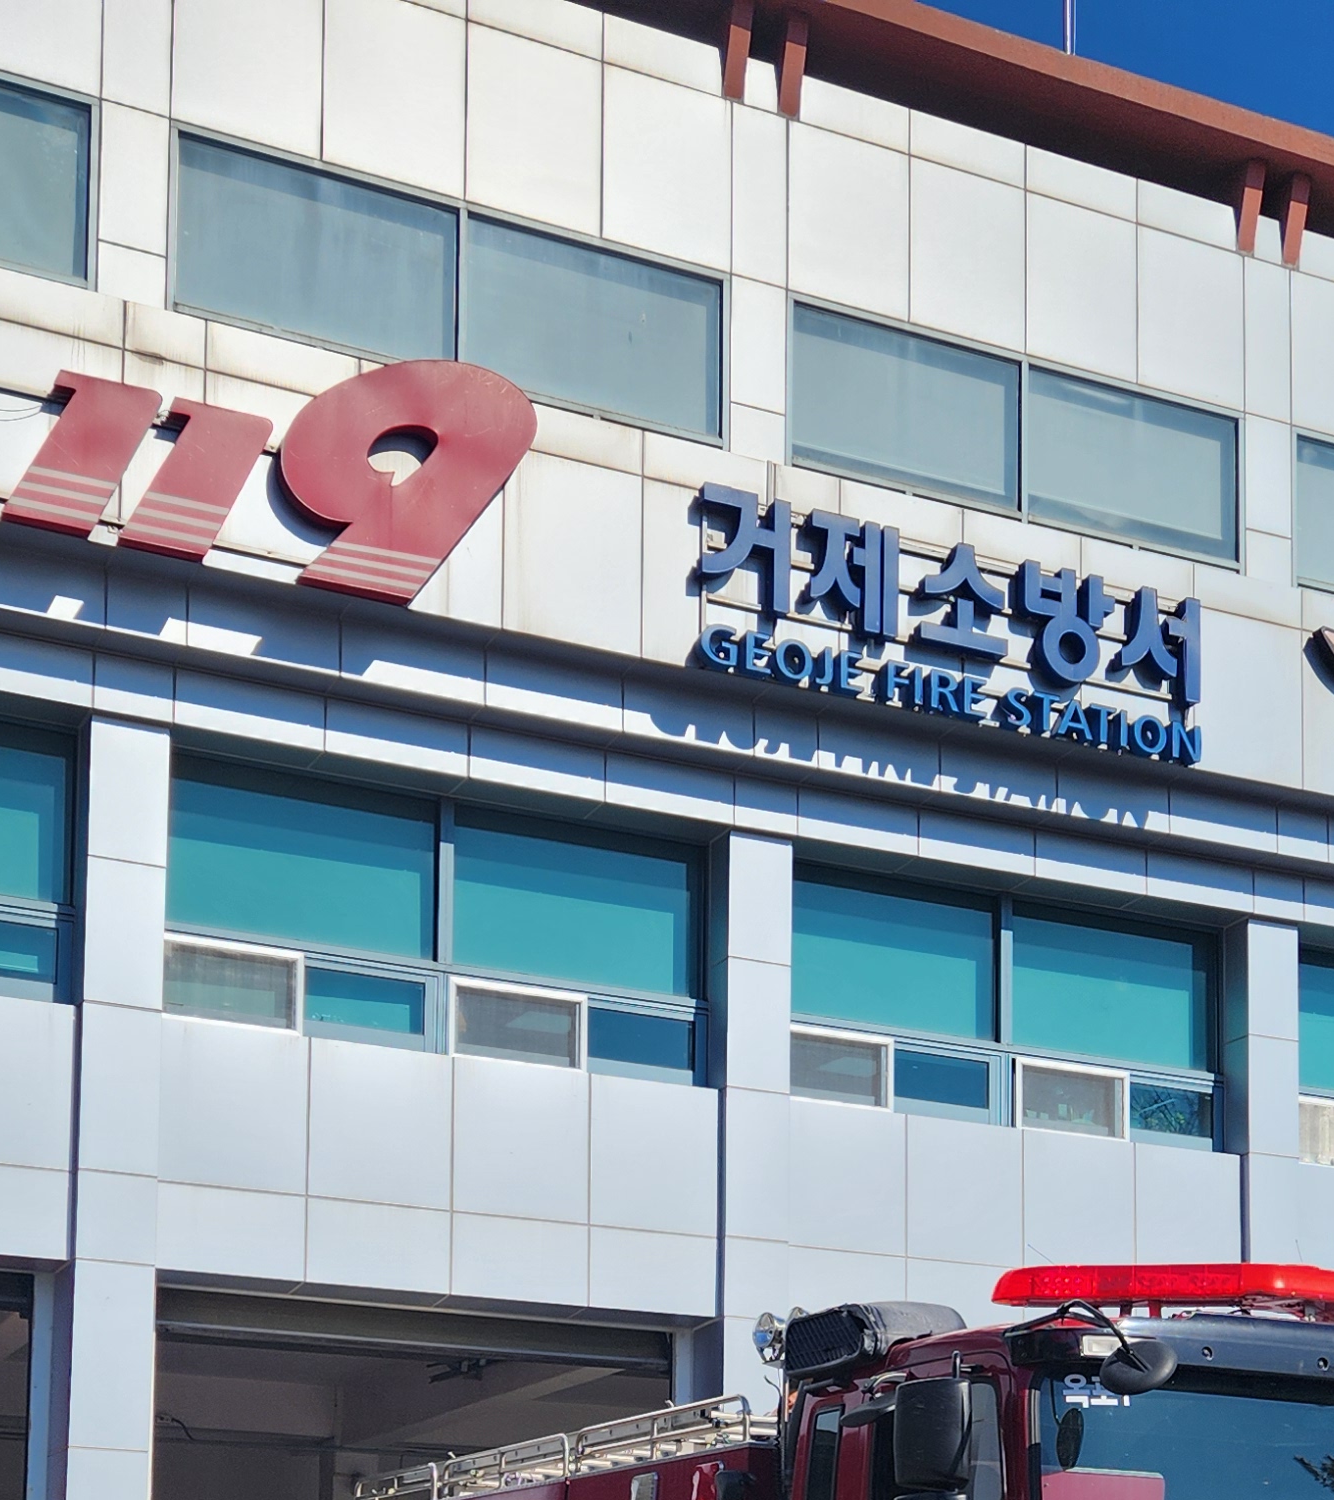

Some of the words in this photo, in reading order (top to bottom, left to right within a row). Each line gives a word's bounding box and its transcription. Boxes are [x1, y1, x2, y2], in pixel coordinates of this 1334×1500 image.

[1, 358, 537, 606] 119
[697, 481, 1201, 706] 거제소방서
[700, 623, 864, 692] GEOJE
[881, 659, 987, 718] FIRE
[1003, 686, 1202, 766] STATION
